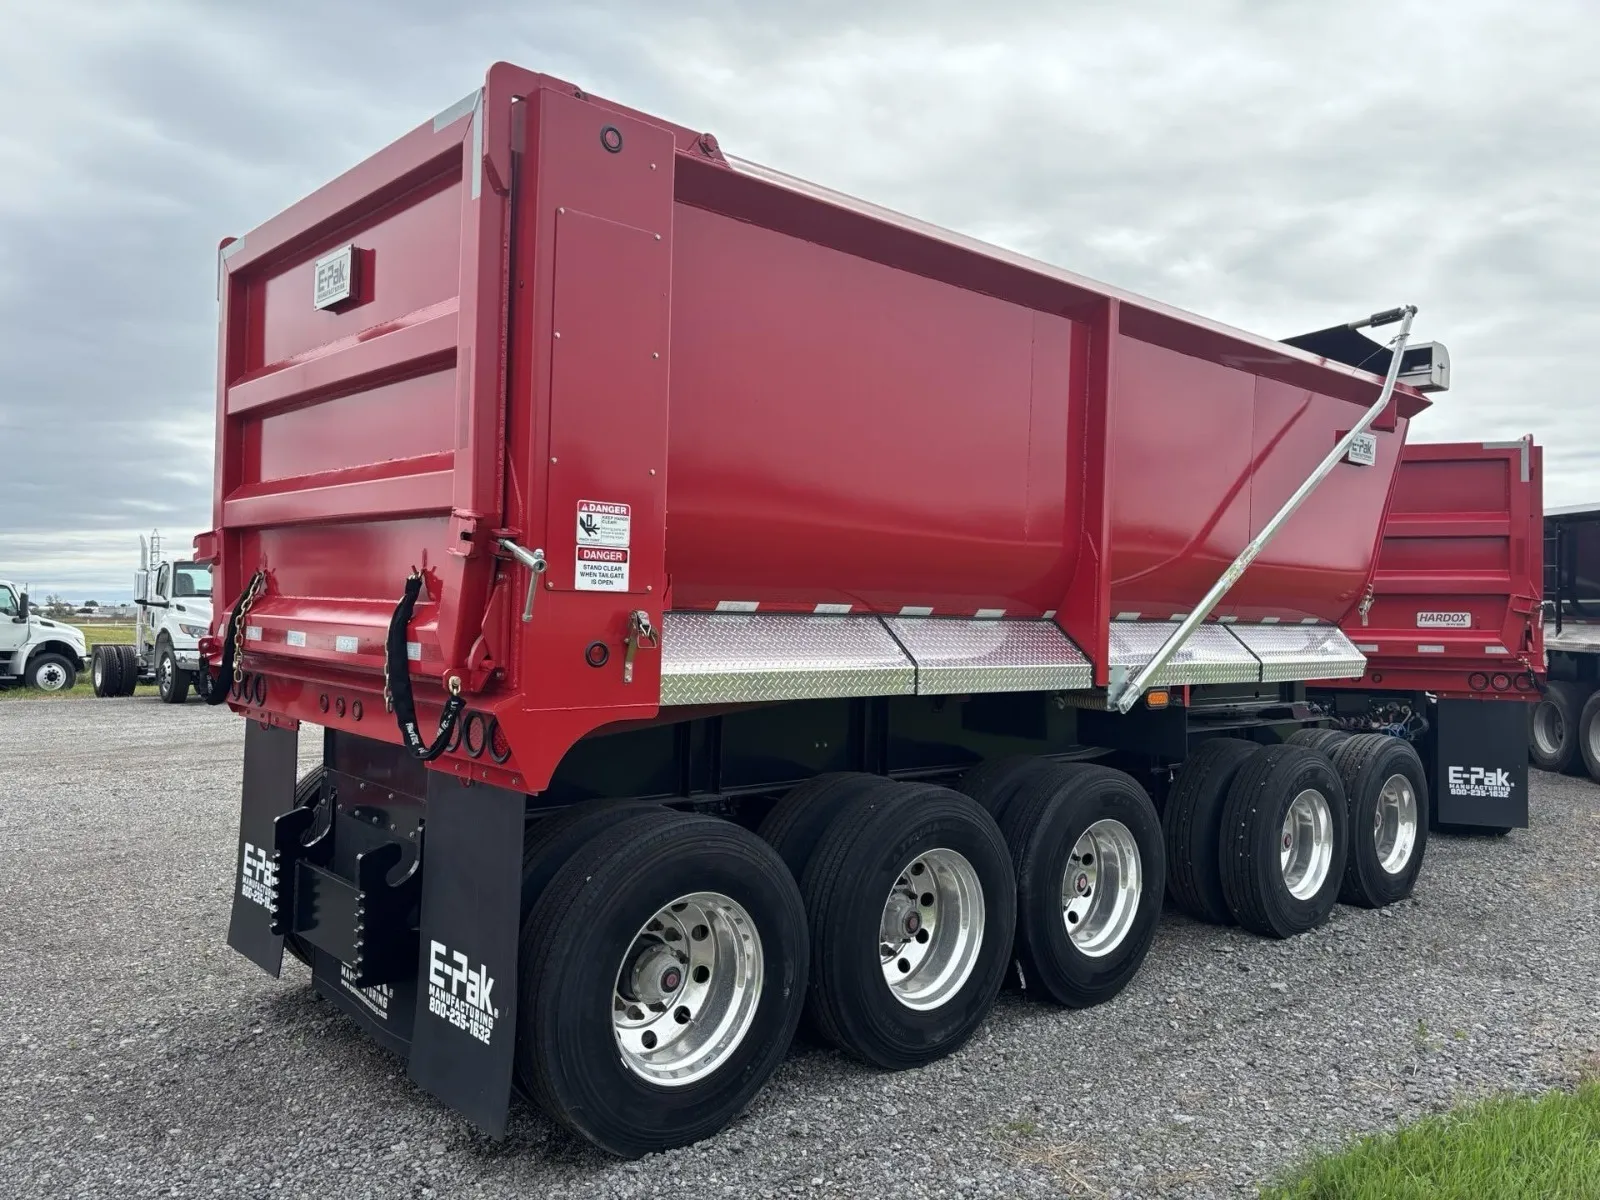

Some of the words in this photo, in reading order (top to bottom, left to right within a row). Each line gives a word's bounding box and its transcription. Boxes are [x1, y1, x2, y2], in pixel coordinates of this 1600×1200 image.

[318, 260, 346, 292] E-Pak
[589, 503, 627, 515] DANGER
[583, 549, 623, 561] DANGER
[598, 572, 624, 580] TAILGATE
[1419, 613, 1467, 623] HARDOX
[1448, 766, 1510, 787] E-Pak
[1449, 783, 1511, 792] MANUFACTURING
[1450, 788, 1509, 798] 800-235-1632
[243, 842, 274, 888] E-Pa
[429, 939, 495, 1017] E-Pak
[428, 983, 495, 1031] MANUFACTURING
[428, 996, 492, 1046] 800-235-1632
